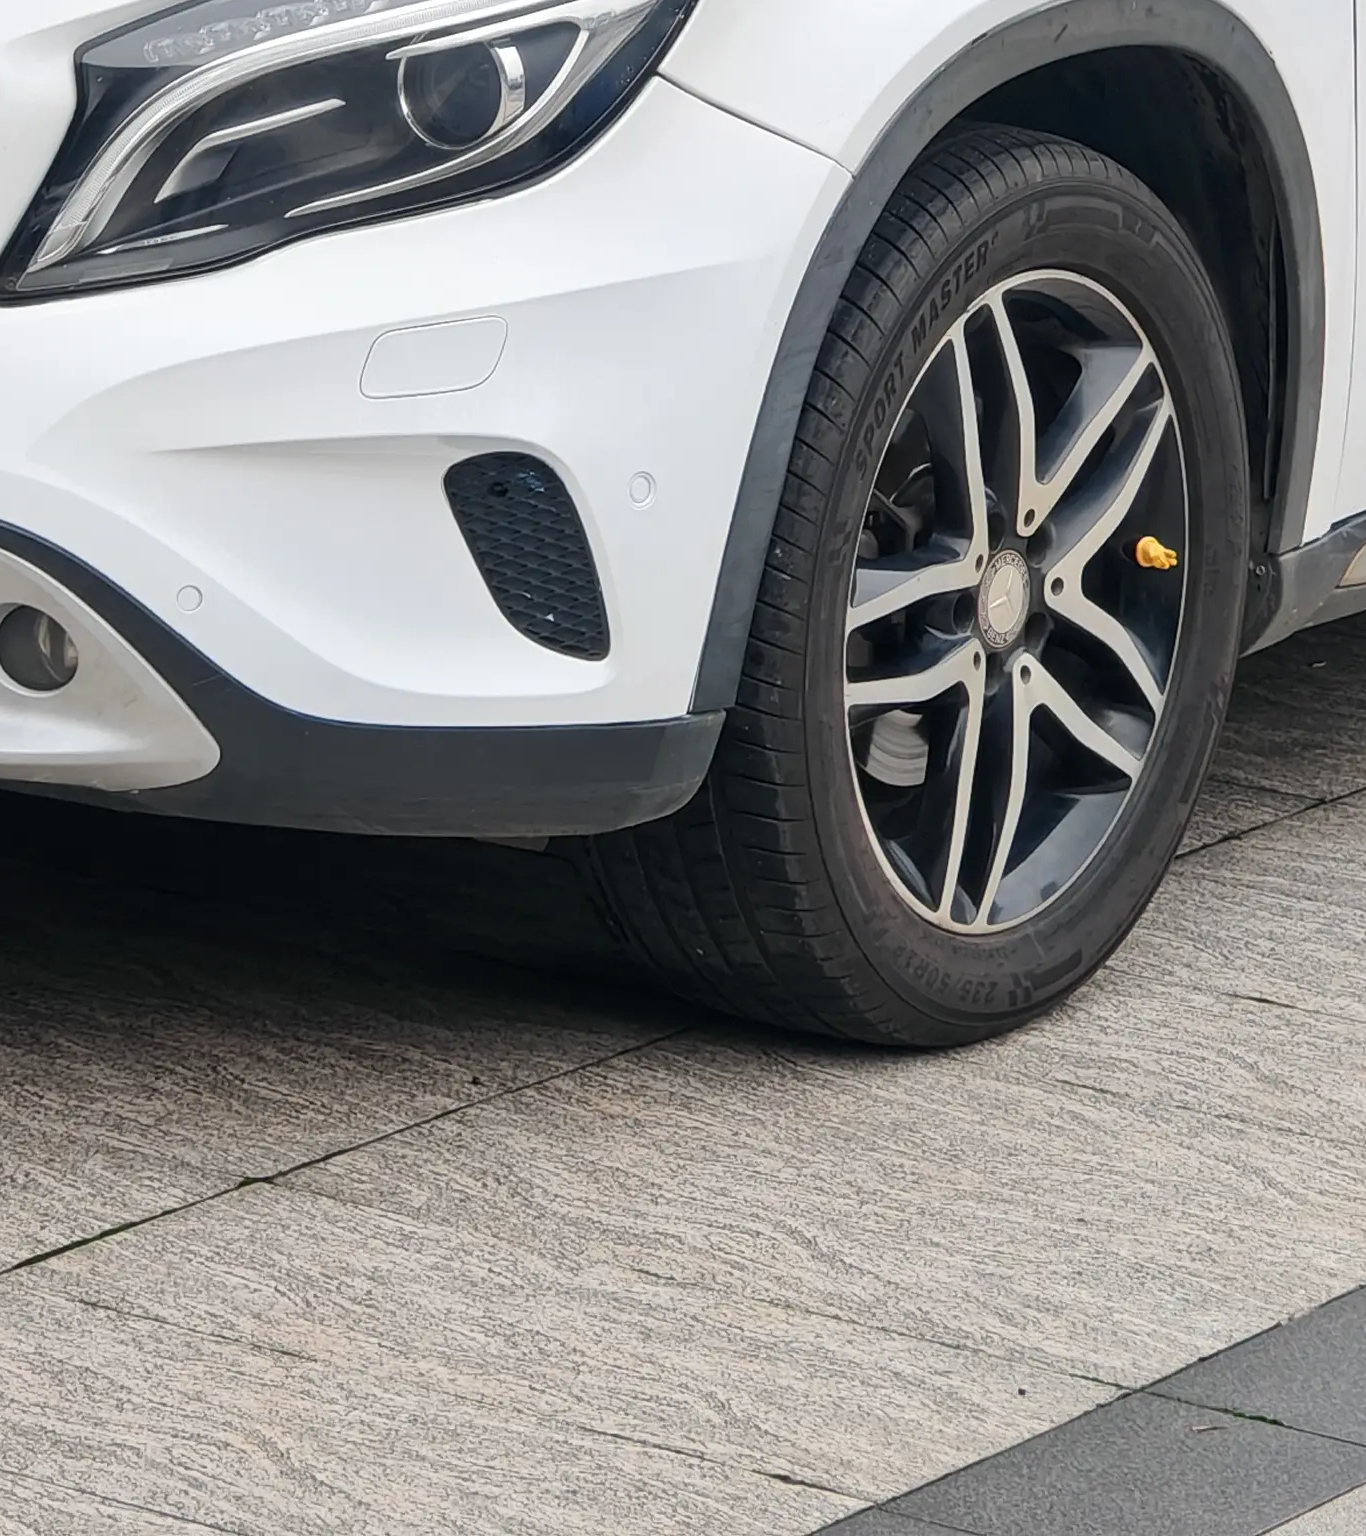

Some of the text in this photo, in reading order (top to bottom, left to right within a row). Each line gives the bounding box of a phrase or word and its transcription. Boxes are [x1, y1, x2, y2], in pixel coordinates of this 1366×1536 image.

[854, 238, 991, 482] SPORT MASTER
[986, 628, 1006, 644] BENZ
